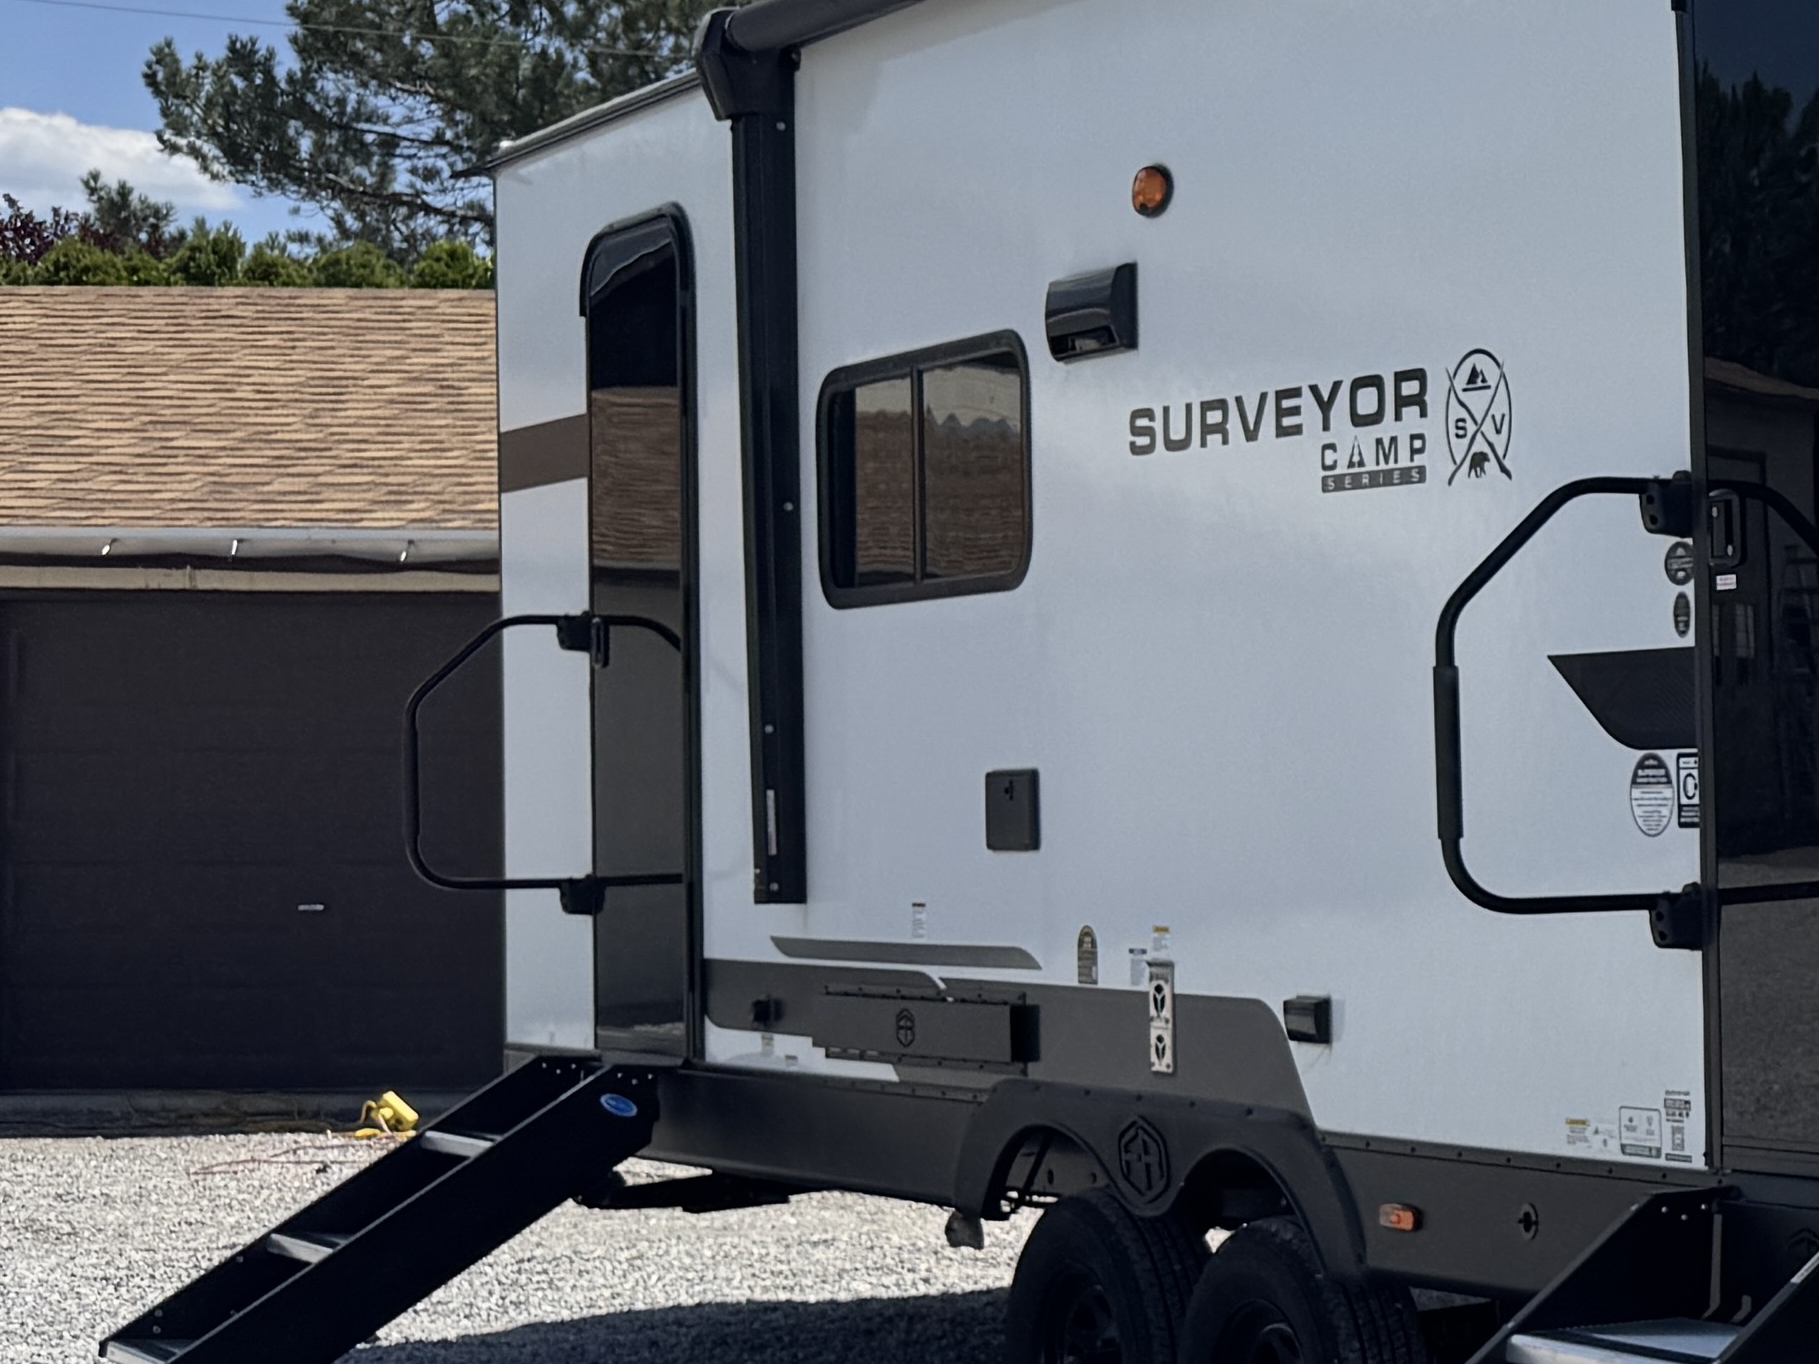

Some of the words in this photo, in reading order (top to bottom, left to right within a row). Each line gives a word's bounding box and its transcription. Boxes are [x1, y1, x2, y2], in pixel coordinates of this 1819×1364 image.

[1129, 367, 1429, 456] SURVEYOR
[1320, 432, 1427, 472] CAMP
[1325, 466, 1422, 491] SERIES
